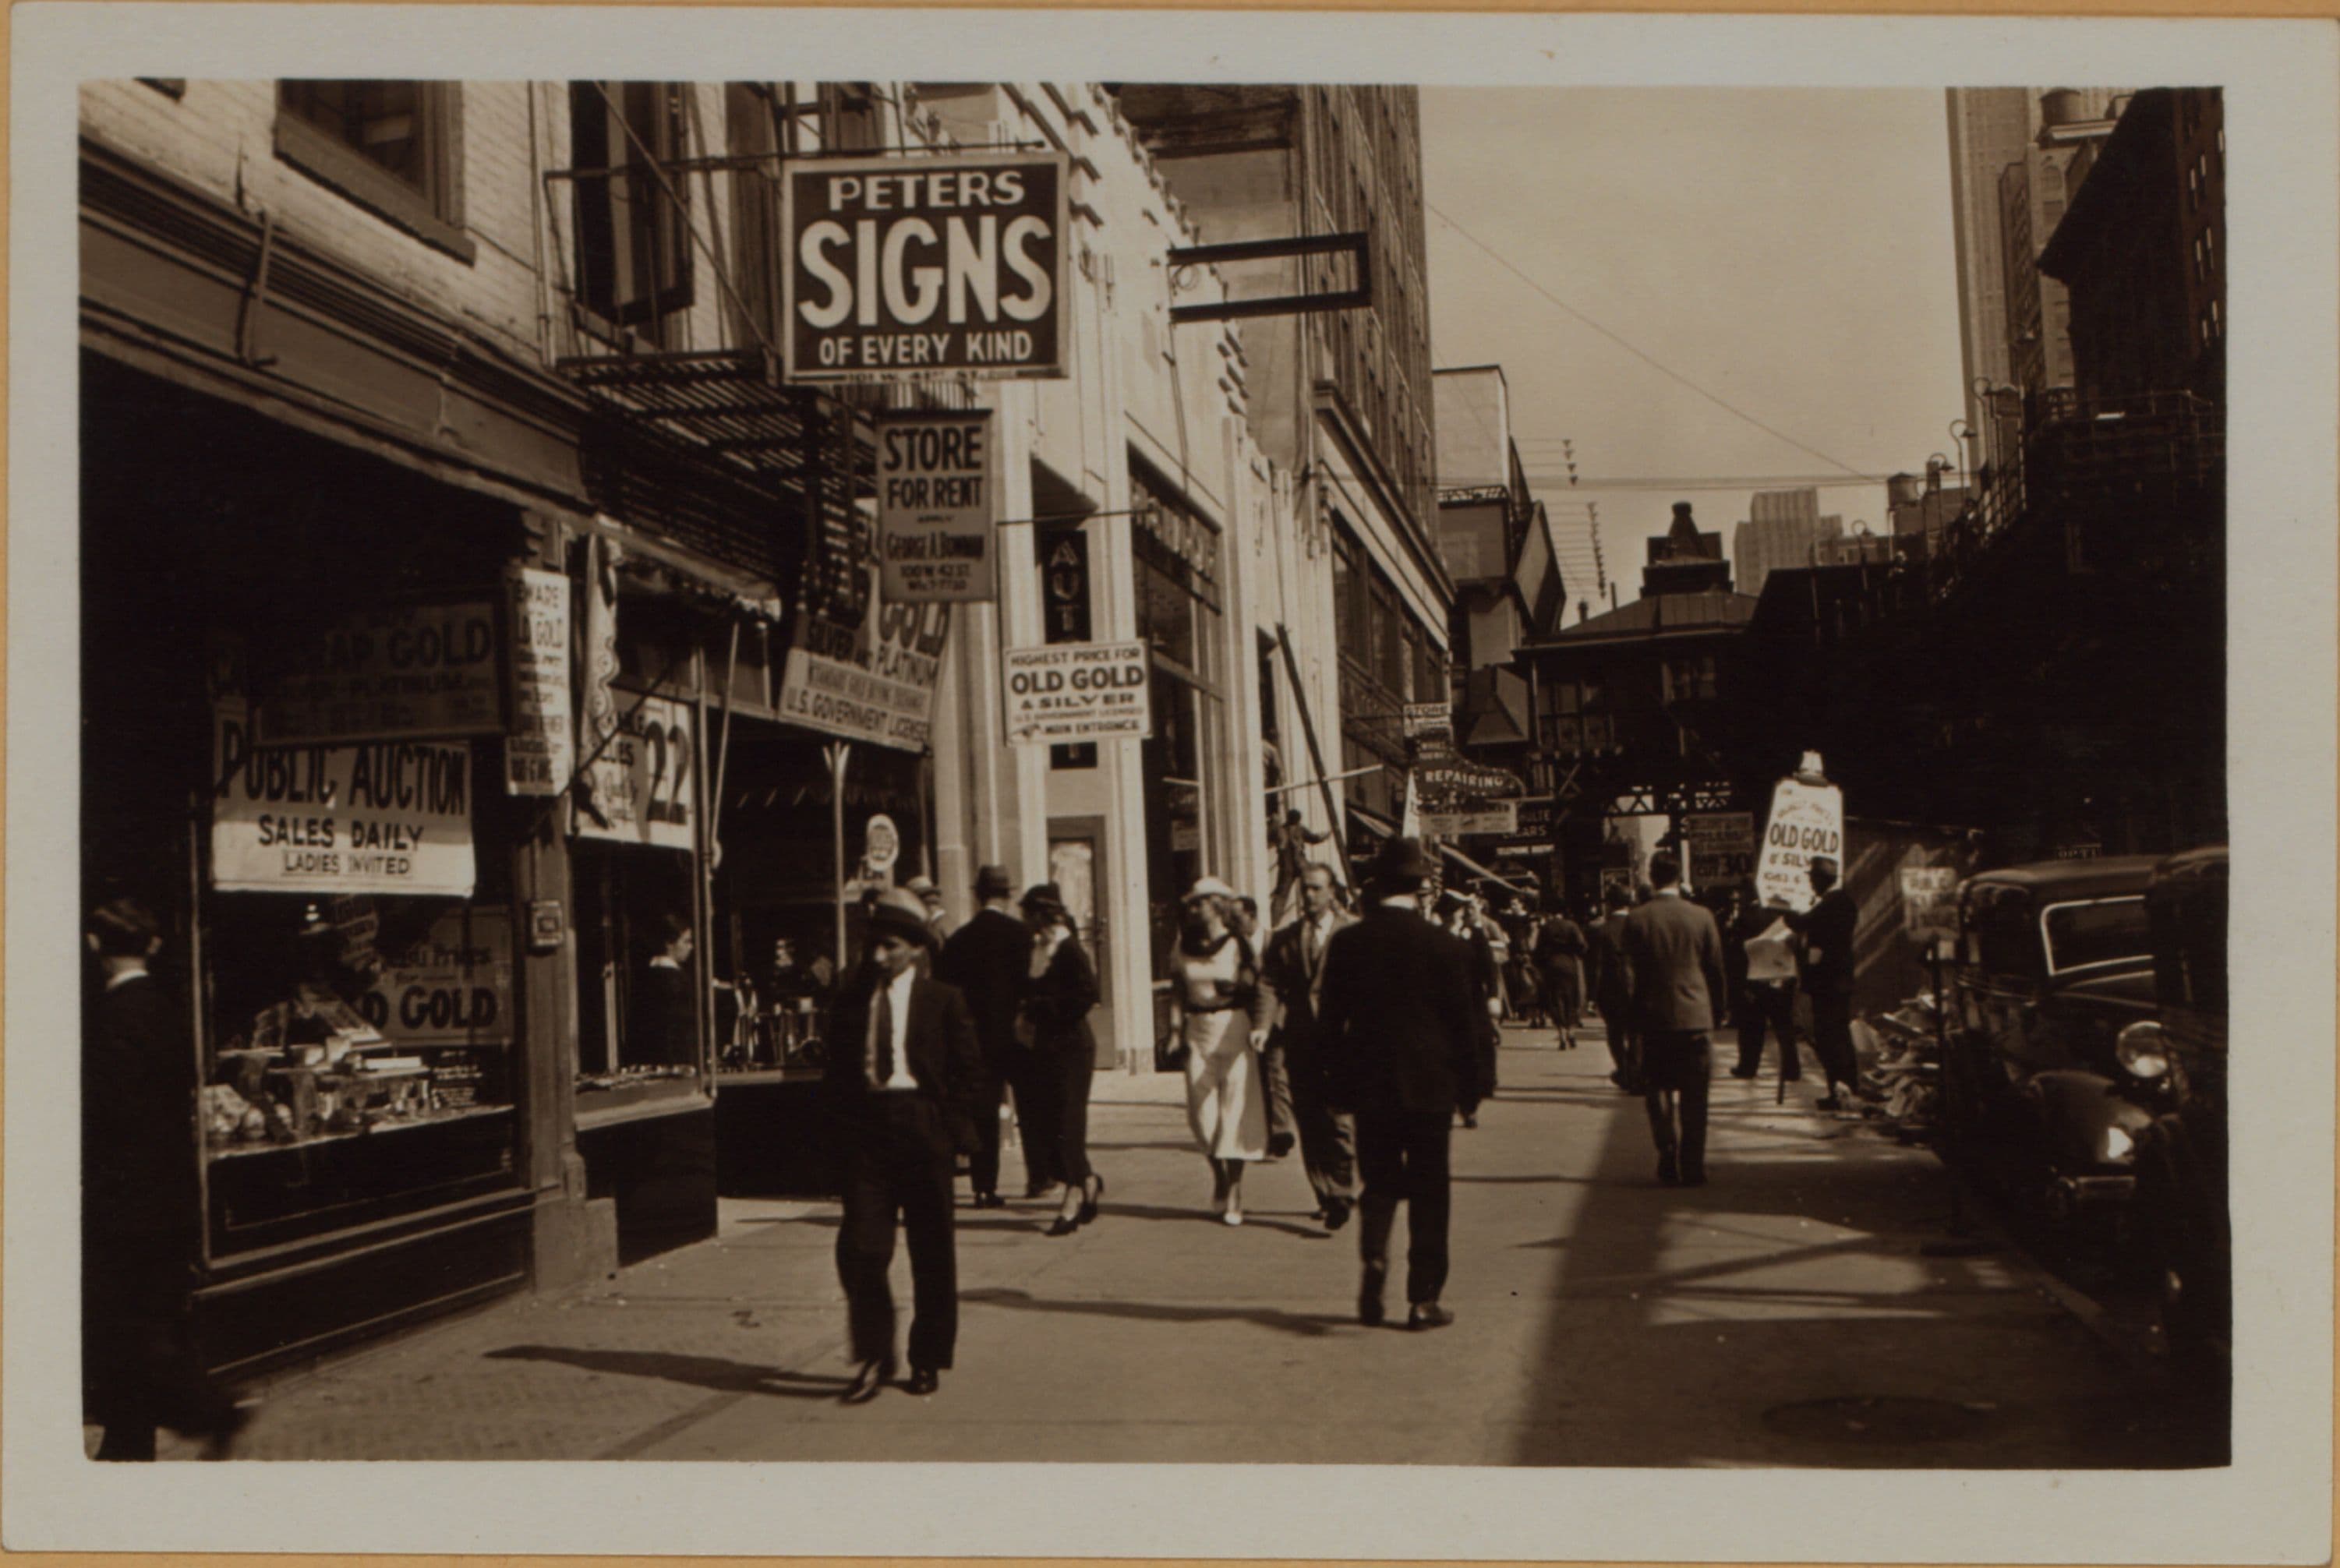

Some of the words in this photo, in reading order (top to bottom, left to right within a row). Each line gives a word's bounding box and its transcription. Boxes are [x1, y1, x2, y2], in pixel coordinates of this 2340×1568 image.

[829, 170, 1025, 212] PETERS
[798, 214, 1052, 329] SIGNS
[819, 336, 854, 366] OF
[861, 333, 950, 366] EVERY
[966, 330, 1032, 362] KIND
[885, 426, 981, 471] STORE
[889, 478, 928, 510] FOR
[933, 476, 982, 507] RENT
[387, 618, 491, 669] GOLD
[1011, 652, 1068, 667] HIGHEST
[1073, 648, 1110, 662] PRICE
[1114, 648, 1140, 660] FOR
[1011, 671, 1064, 695] OLD
[1071, 665, 1144, 690] GOLD
[1038, 693, 1135, 708] SILVER
[222, 720, 338, 805] PUBLIC
[348, 742, 465, 817] AUCTION
[1425, 768, 1504, 787] REPAIRING
[259, 815, 335, 848] SALES
[352, 821, 425, 851] DAILY
[1769, 822, 1798, 849] OLD
[1801, 827, 1839, 854] GOLD
[285, 855, 340, 875] LADIES
[348, 856, 411, 876] INVITED
[400, 984, 497, 1030] GOLD
